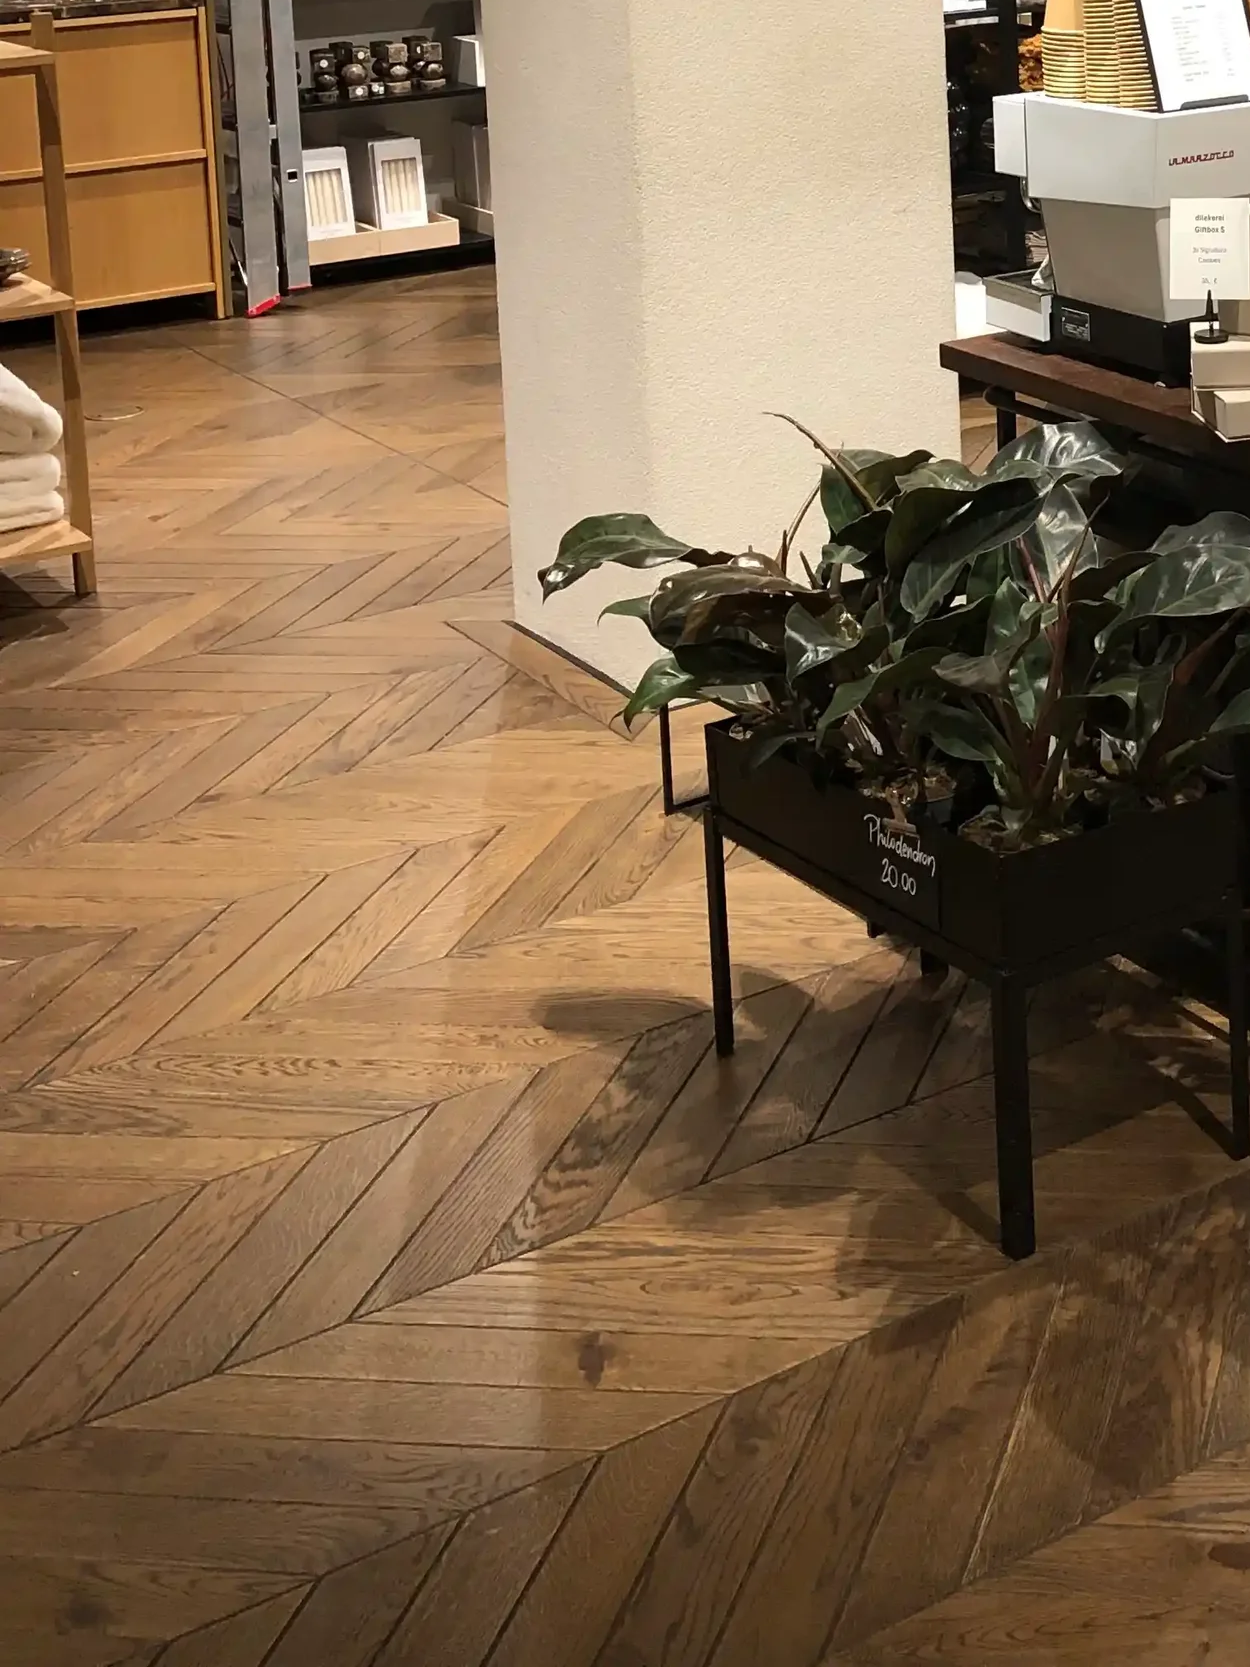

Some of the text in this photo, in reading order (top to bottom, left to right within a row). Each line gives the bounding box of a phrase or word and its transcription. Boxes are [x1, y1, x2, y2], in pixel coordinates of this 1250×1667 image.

[1181, 149, 1235, 165] MARZOCCO
[1194, 213, 1225, 222] dilekerei
[1194, 225, 1226, 234] Giftbox S
